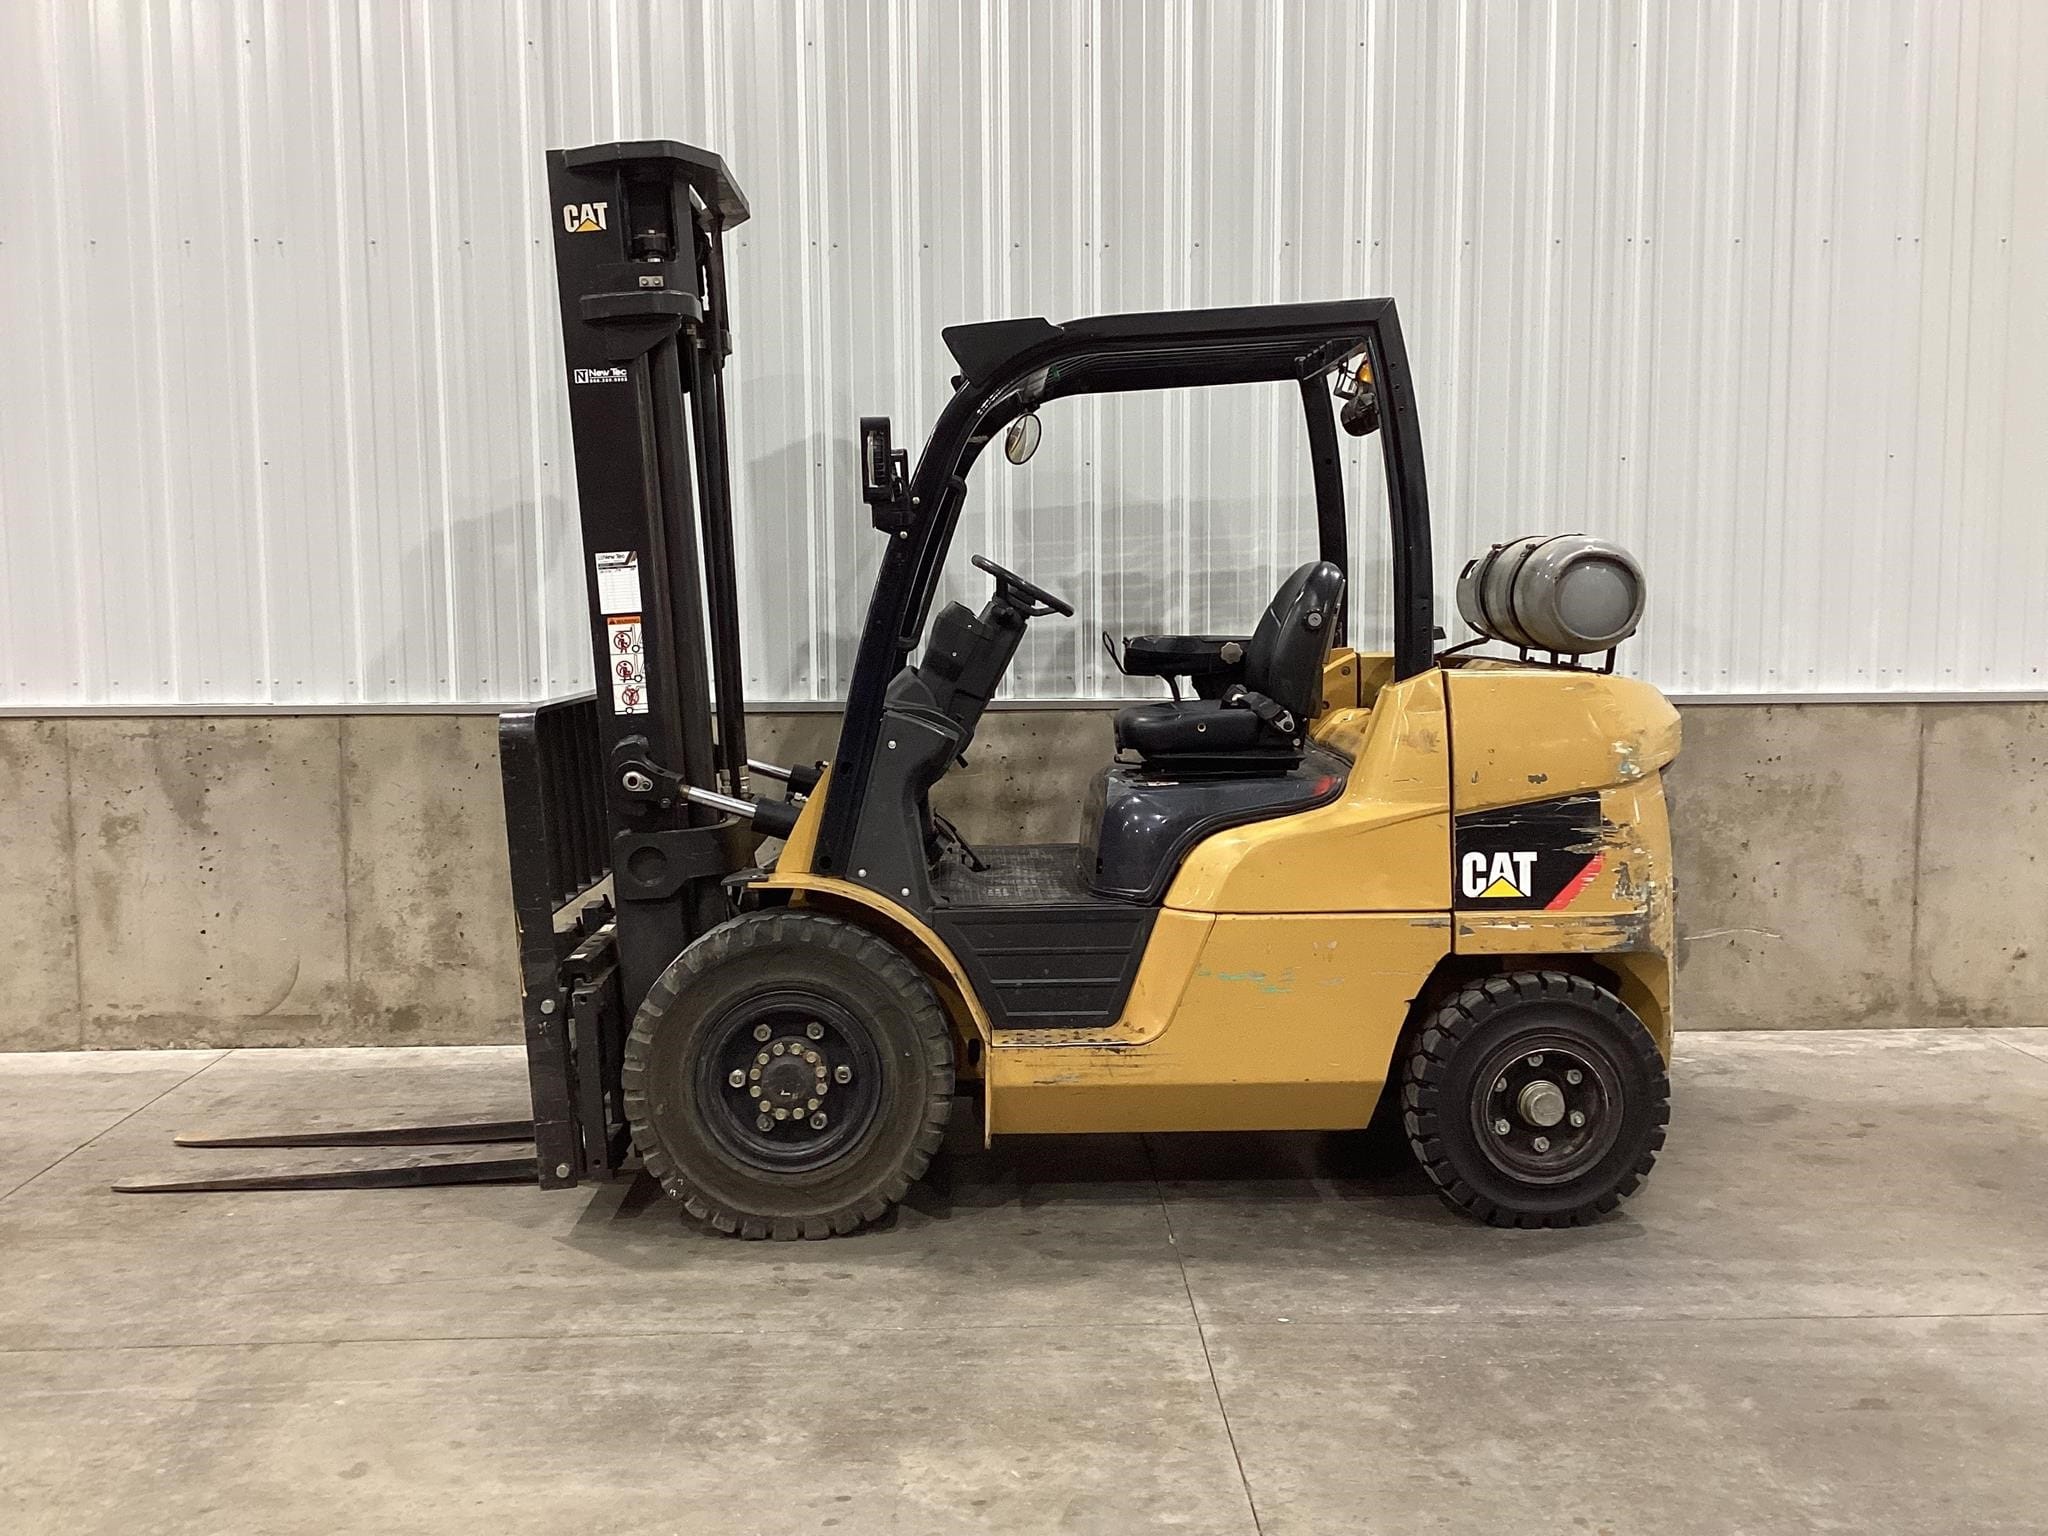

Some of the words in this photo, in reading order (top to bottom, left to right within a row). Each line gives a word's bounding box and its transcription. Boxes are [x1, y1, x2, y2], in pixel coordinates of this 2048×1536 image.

[563, 202, 608, 232] CAT
[589, 369, 610, 377] New
[610, 368, 627, 376] Tec
[1462, 851, 1538, 898] CAT
